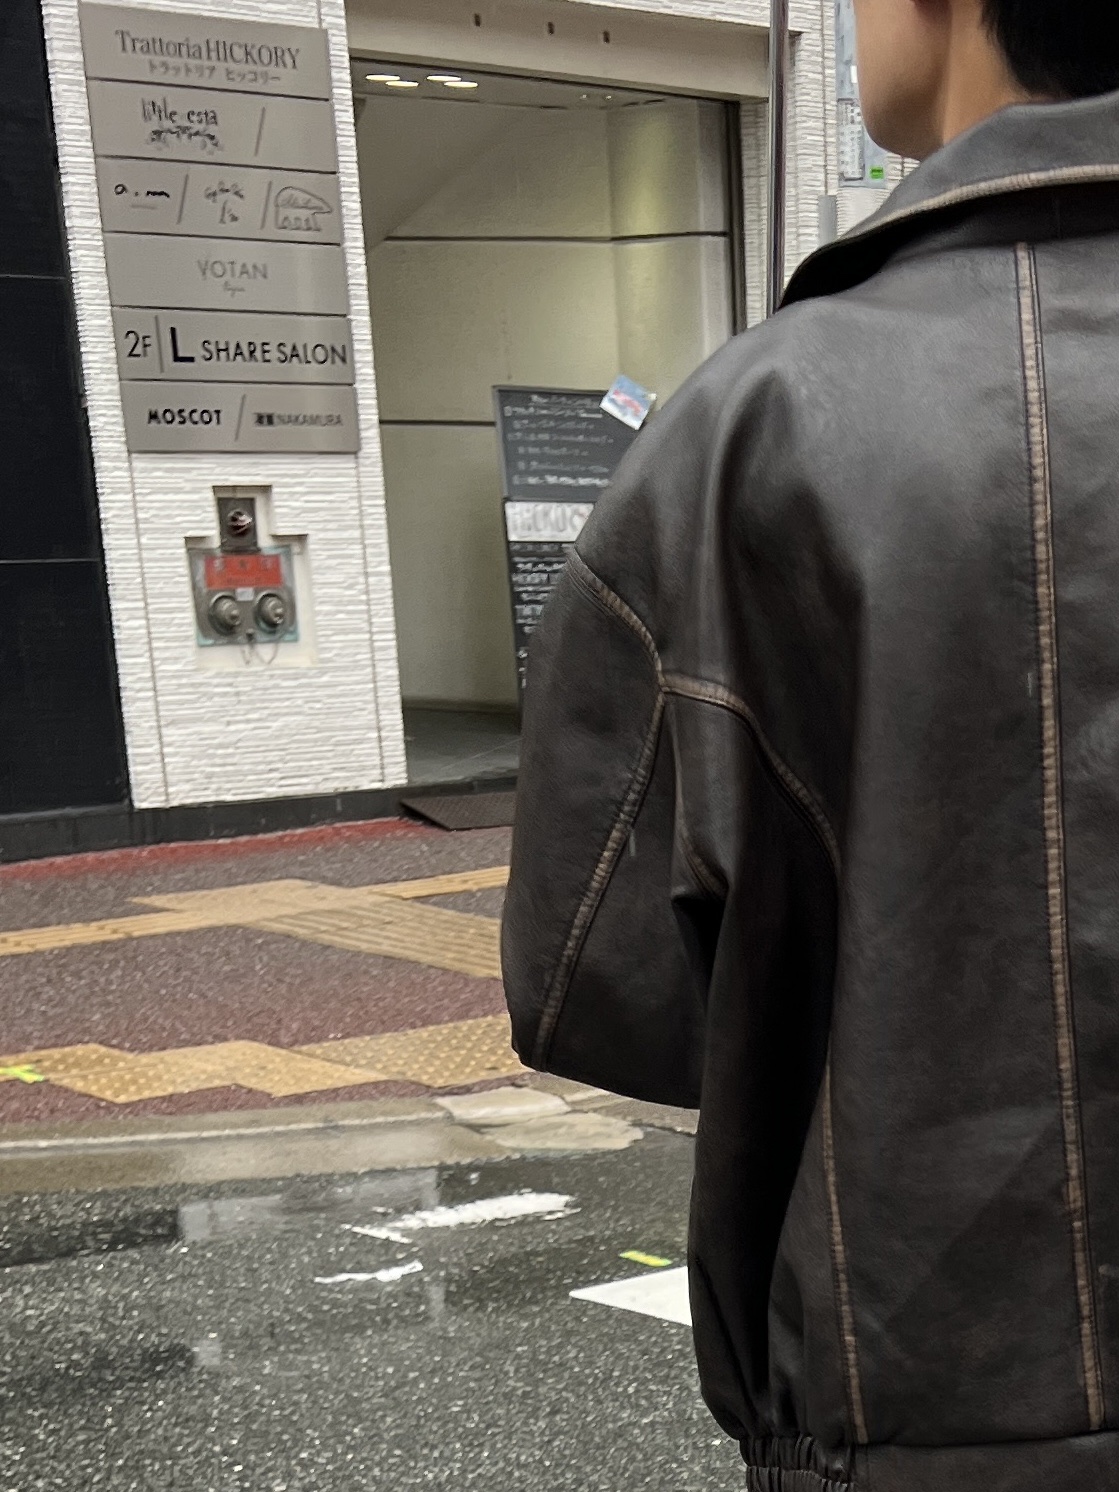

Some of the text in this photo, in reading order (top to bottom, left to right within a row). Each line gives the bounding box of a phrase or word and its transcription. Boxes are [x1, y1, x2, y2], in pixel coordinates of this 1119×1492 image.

[115, 29, 301, 70] Trattoria HICKORY
[124, 326, 348, 366] 2F L SHARE SALON
[147, 408, 223, 426] MOSCOT
